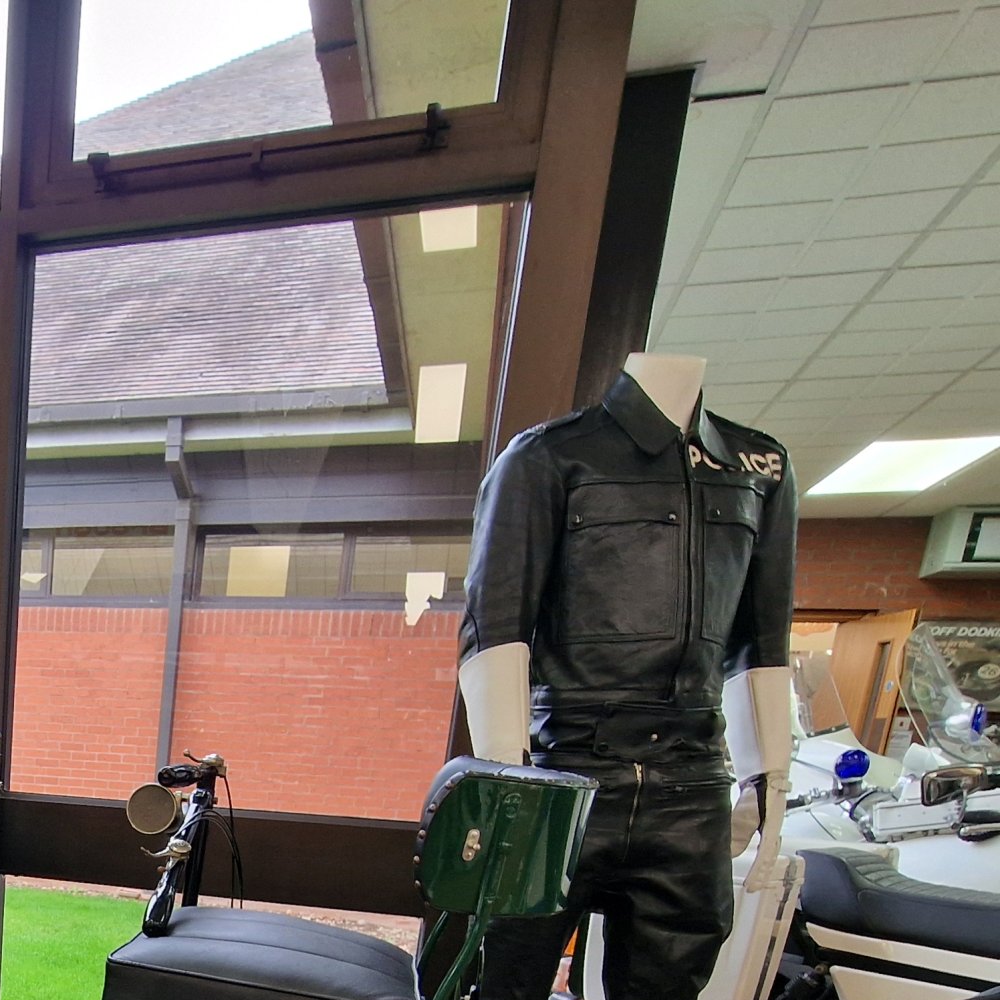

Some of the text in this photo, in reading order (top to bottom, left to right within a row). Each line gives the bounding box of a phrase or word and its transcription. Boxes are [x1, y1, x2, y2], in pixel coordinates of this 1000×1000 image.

[688, 444, 782, 481] POICE
[930, 626, 1000, 638] OFF DODKI
